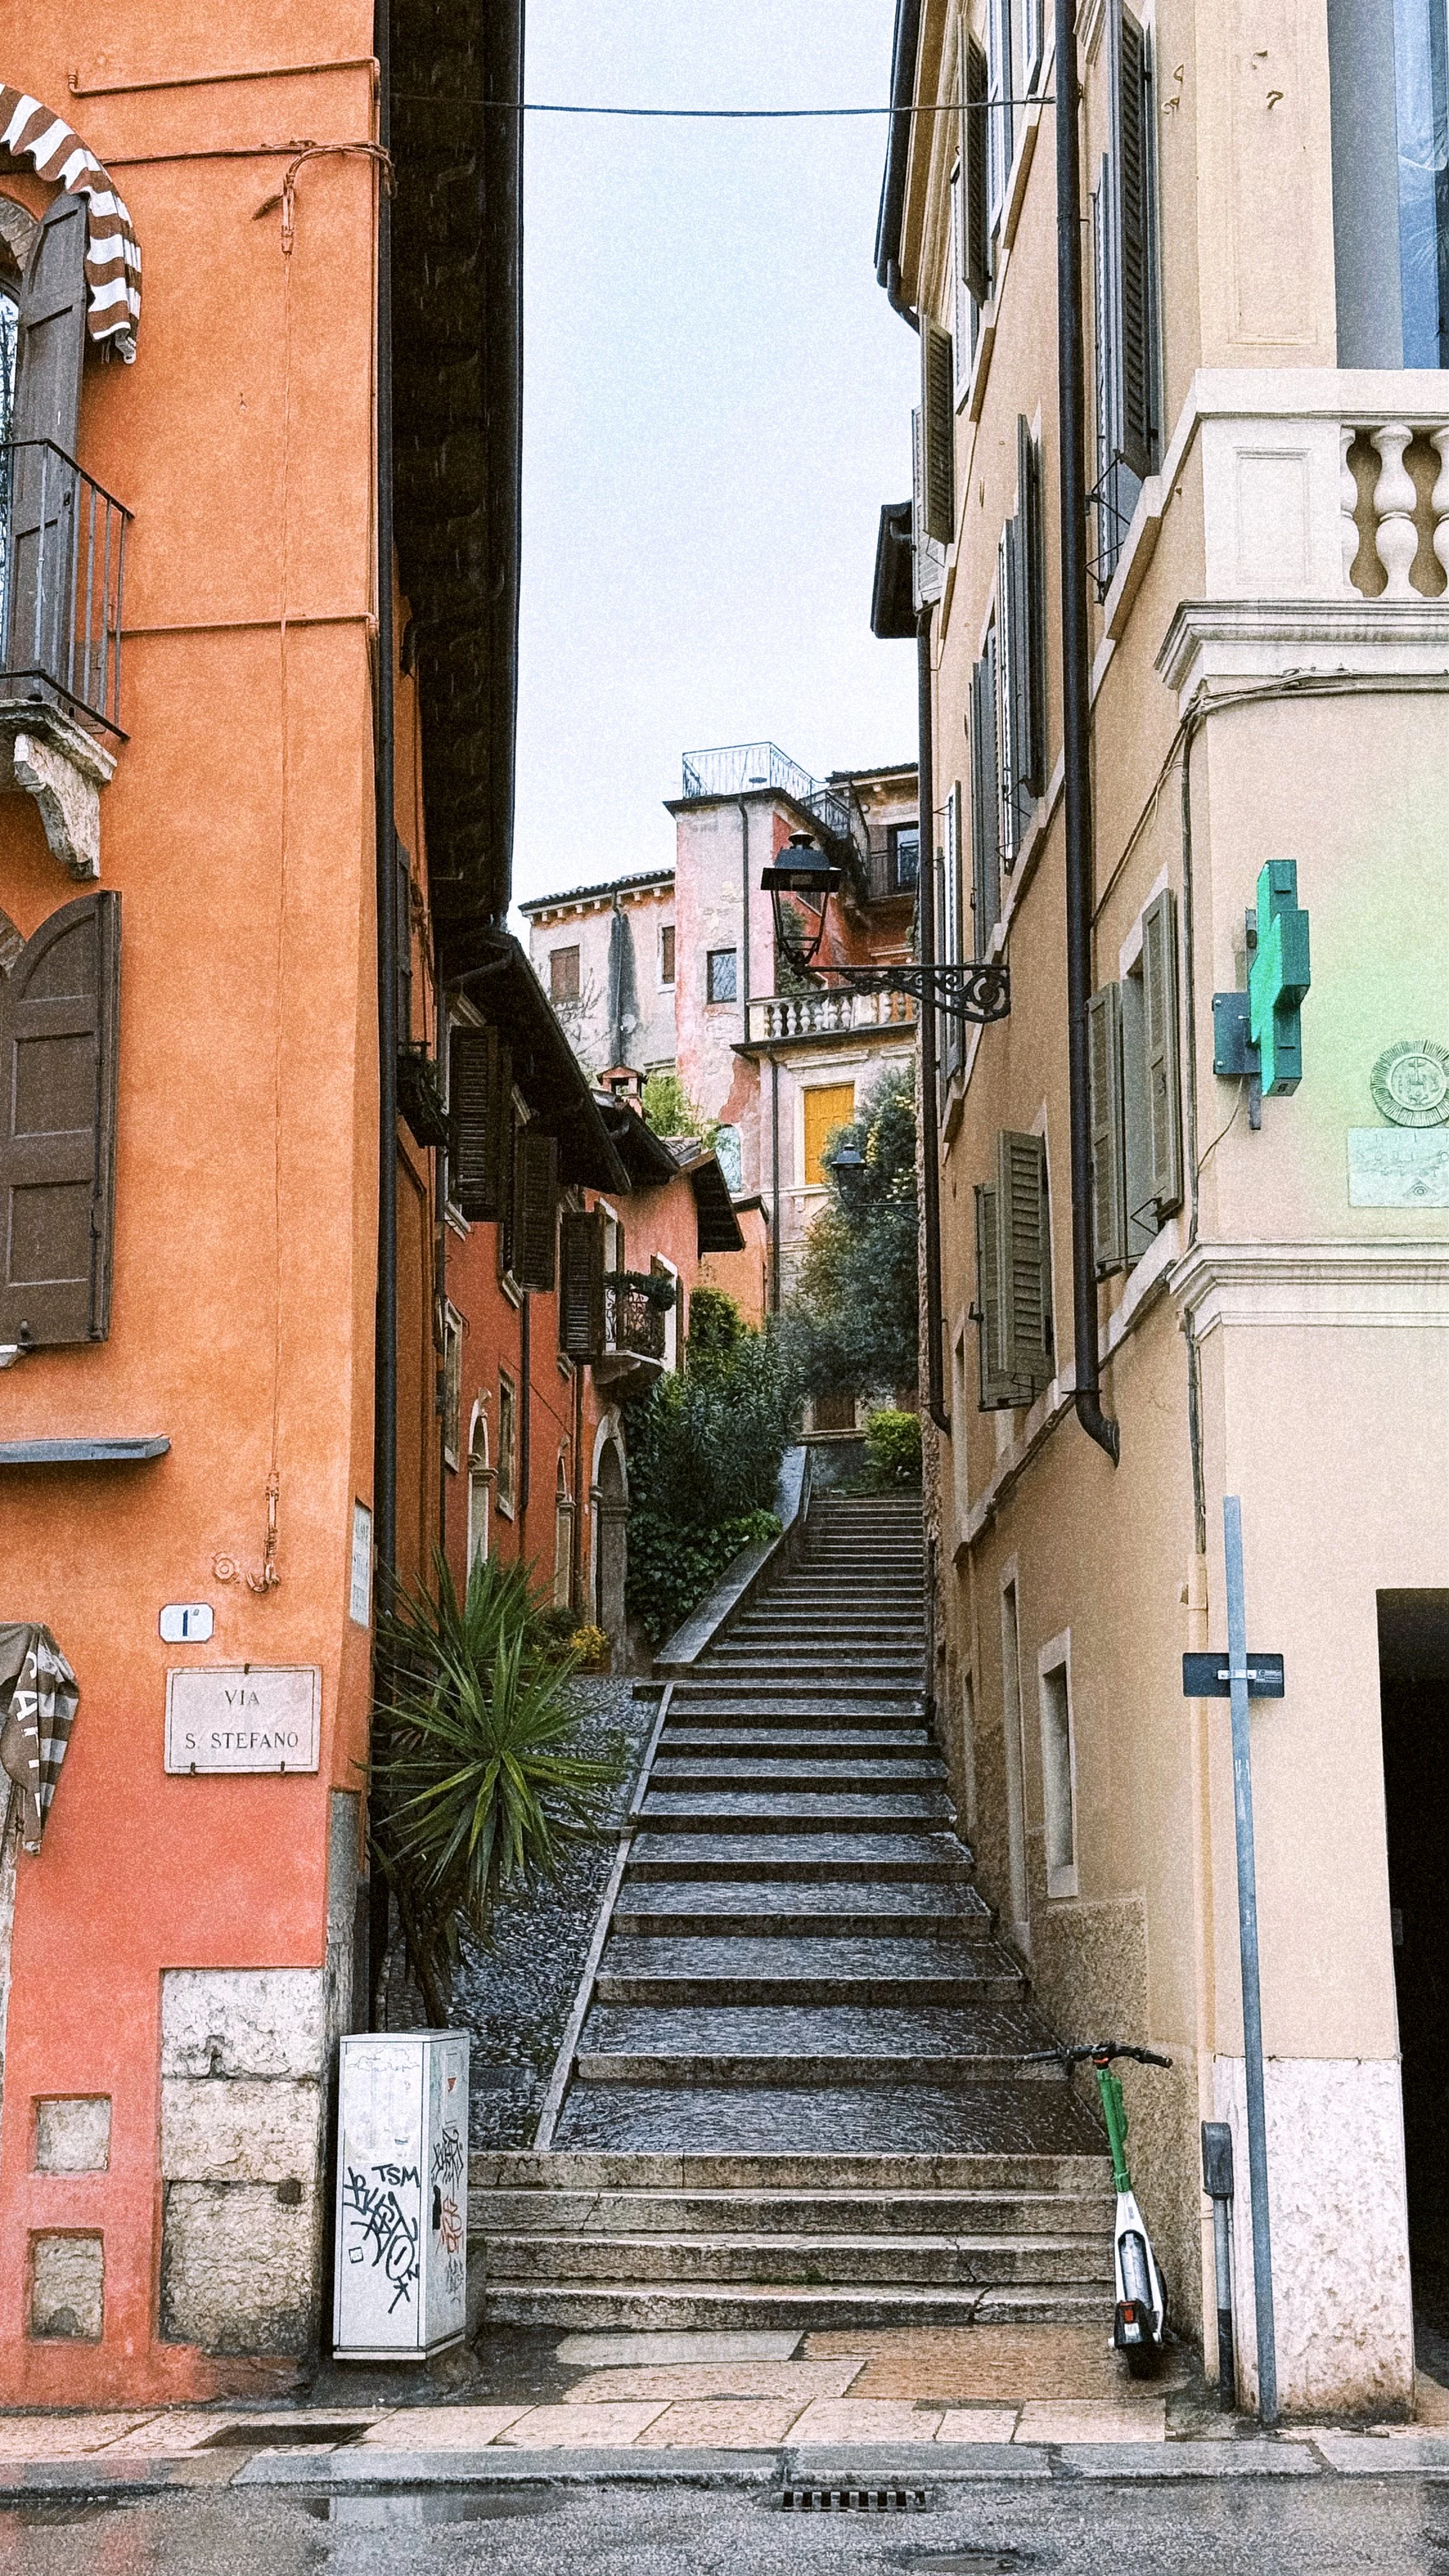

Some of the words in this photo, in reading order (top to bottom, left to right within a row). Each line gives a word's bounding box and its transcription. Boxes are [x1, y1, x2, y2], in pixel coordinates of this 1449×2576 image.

[225, 1689, 259, 1706] VIA
[211, 1731, 298, 1749] STEFANO
[371, 2163, 421, 2188] TSM
